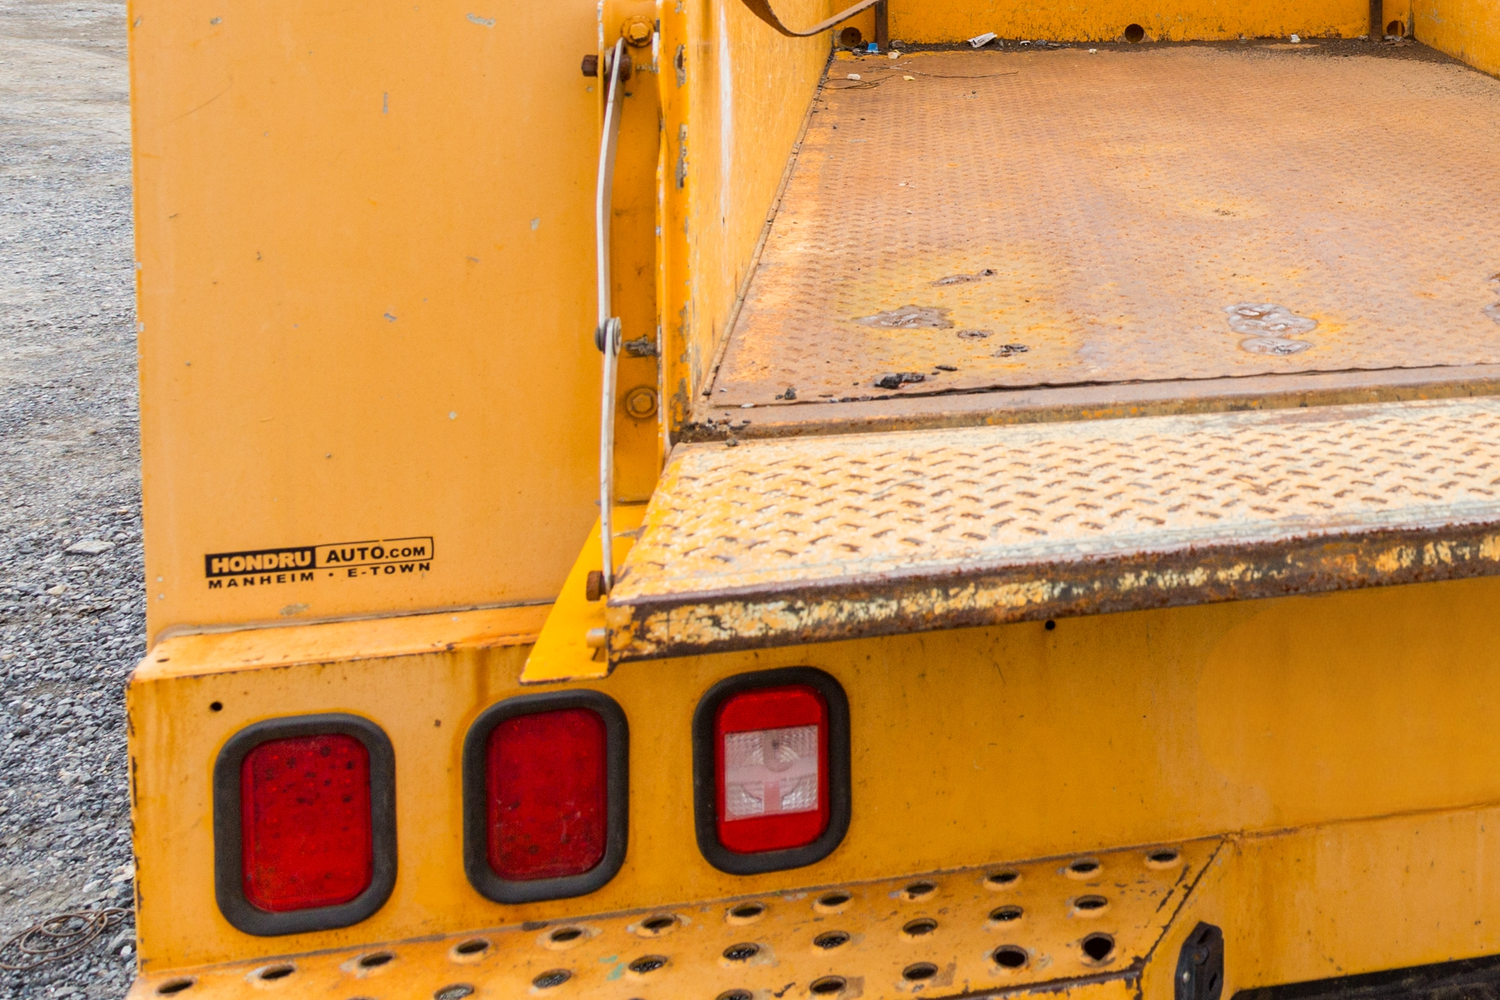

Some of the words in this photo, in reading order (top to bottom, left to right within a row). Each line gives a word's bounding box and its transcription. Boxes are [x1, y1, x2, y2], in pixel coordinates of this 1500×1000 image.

[211, 550, 312, 574] HONDRU
[208, 572, 314, 589] MANHEIM
[347, 562, 430, 578] E-TOWN
